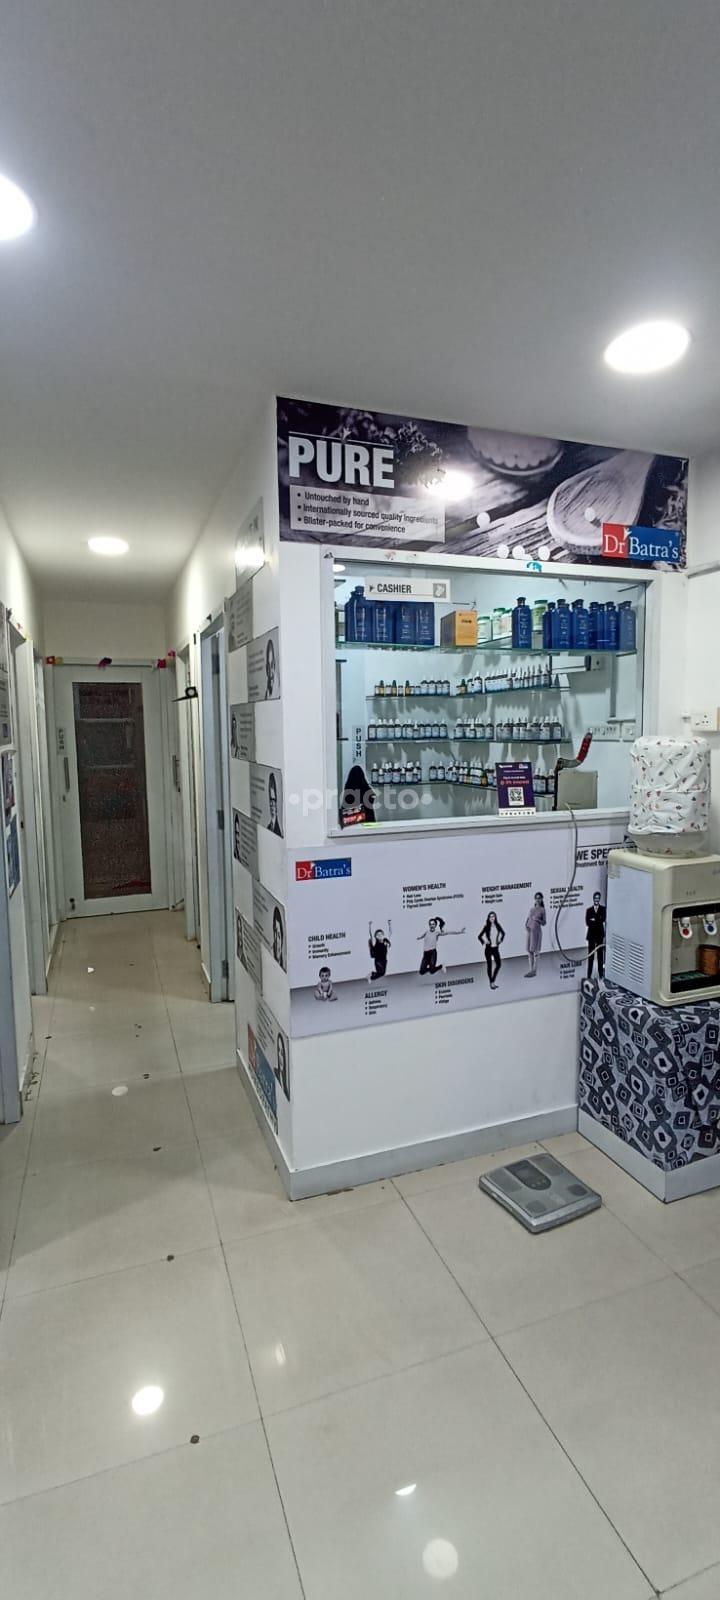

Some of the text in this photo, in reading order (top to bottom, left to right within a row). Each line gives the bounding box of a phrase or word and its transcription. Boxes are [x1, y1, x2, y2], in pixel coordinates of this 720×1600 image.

[288, 436, 394, 488] PURE
[304, 492, 369, 506] Untouched by hand
[303, 502, 438, 525] Internationally sourced quality ingredients
[304, 517, 406, 533] Blister-packed for convenience
[604, 534, 679, 559] Dr Batra's
[377, 584, 412, 593] CASHIER
[576, 850, 588, 860] WE
[297, 864, 351, 879] Dr Batra's
[427, 882, 446, 890] HEALTH
[501, 882, 532, 890] MANAGEMENT
[326, 932, 346, 940] HEALTH
[448, 977, 474, 986] DISORDERS
[365, 990, 388, 998] ALLERGY
